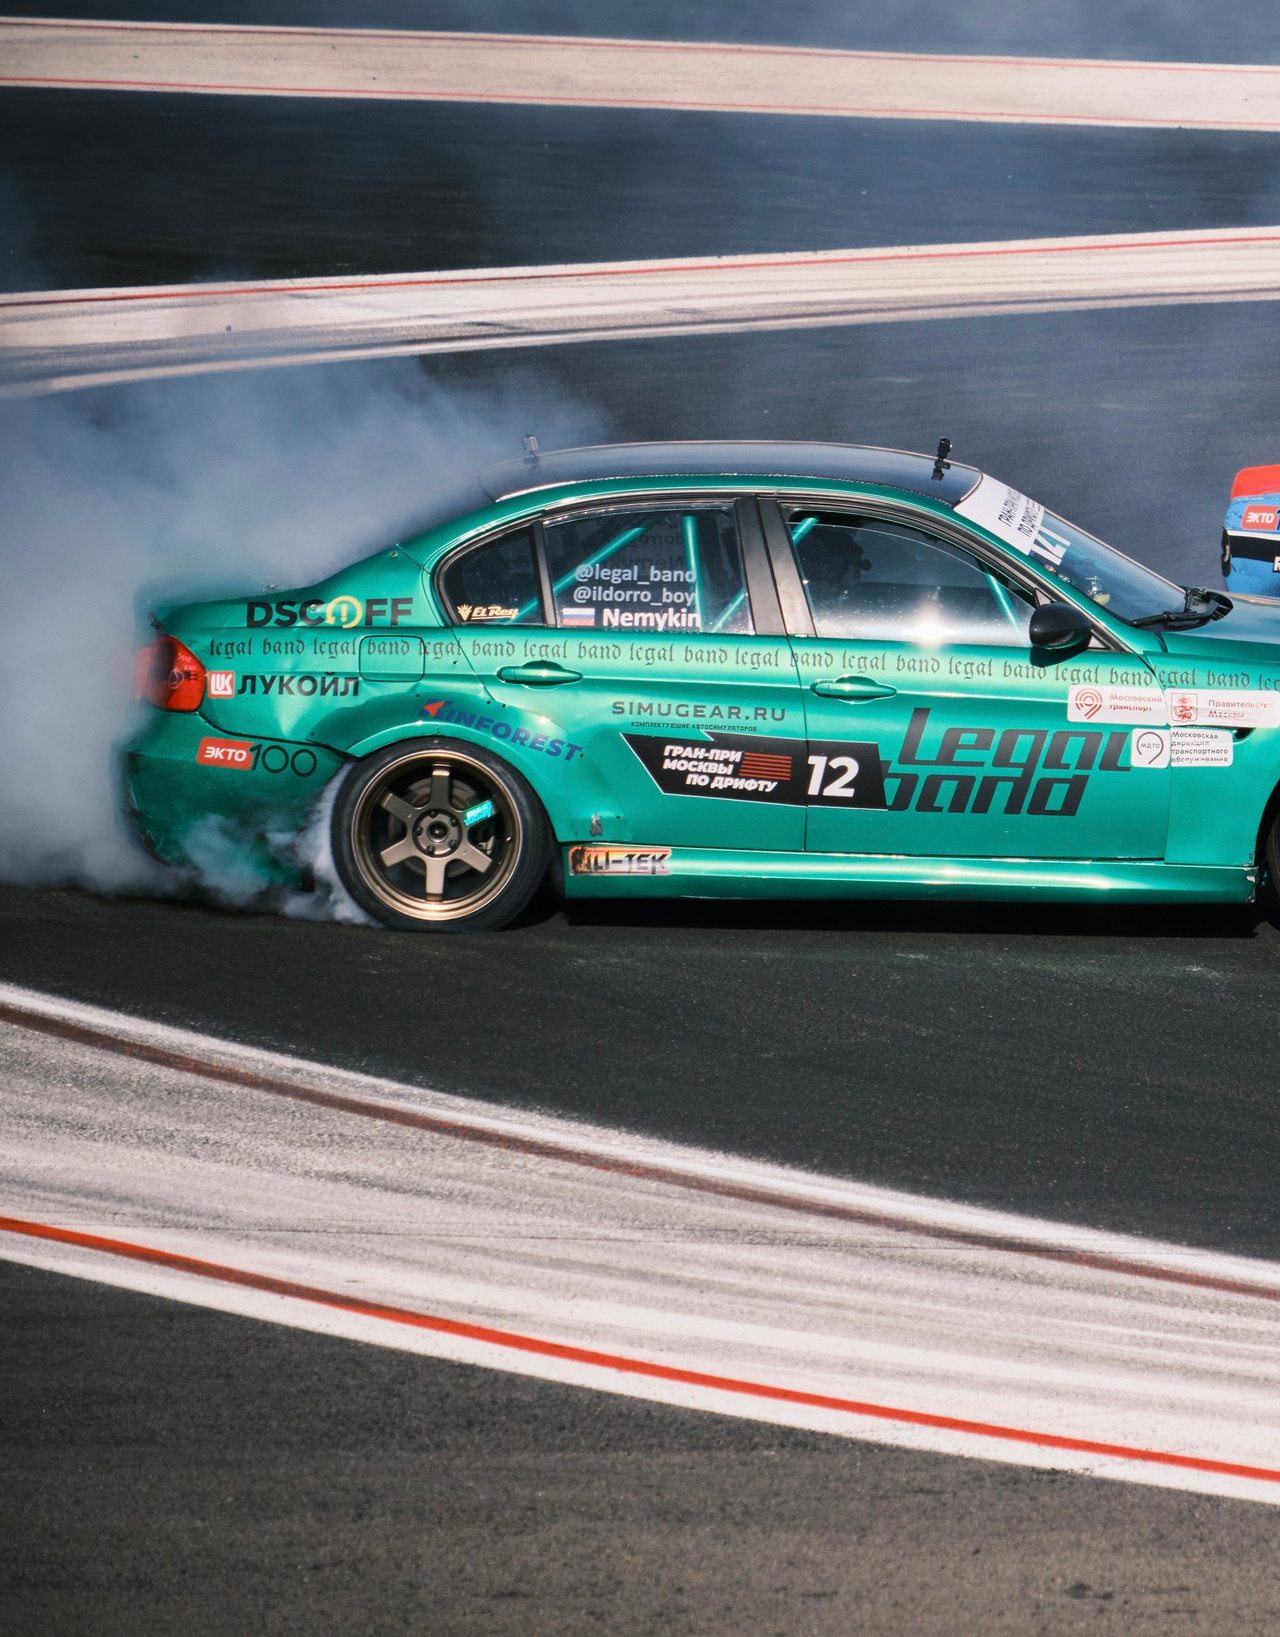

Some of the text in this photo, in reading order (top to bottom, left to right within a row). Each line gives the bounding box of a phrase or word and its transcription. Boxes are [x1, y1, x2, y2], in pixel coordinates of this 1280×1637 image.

[1246, 511, 1274, 524] ЭКТО
[575, 563, 697, 584] @legal_band
[573, 586, 696, 606] @ildorro_boy
[603, 608, 702, 631] Nemykin
[238, 672, 359, 696] ЛУКОЙЛ
[1109, 694, 1162, 703] Московский
[1109, 704, 1152, 712] транспорт
[612, 701, 786, 721] SIMUGEAR.RU
[417, 699, 584, 761] KINFOREST
[1171, 731, 1219, 739] Московская
[663, 744, 743, 763] ГРАН-ПРИ
[1171, 740, 1210, 748] дирекция
[204, 743, 318, 778] ЭКТО 100
[662, 759, 734, 775] МОСКВЫ
[686, 773, 778, 793] ПО ДРИФТУ
[807, 755, 860, 798] 12
